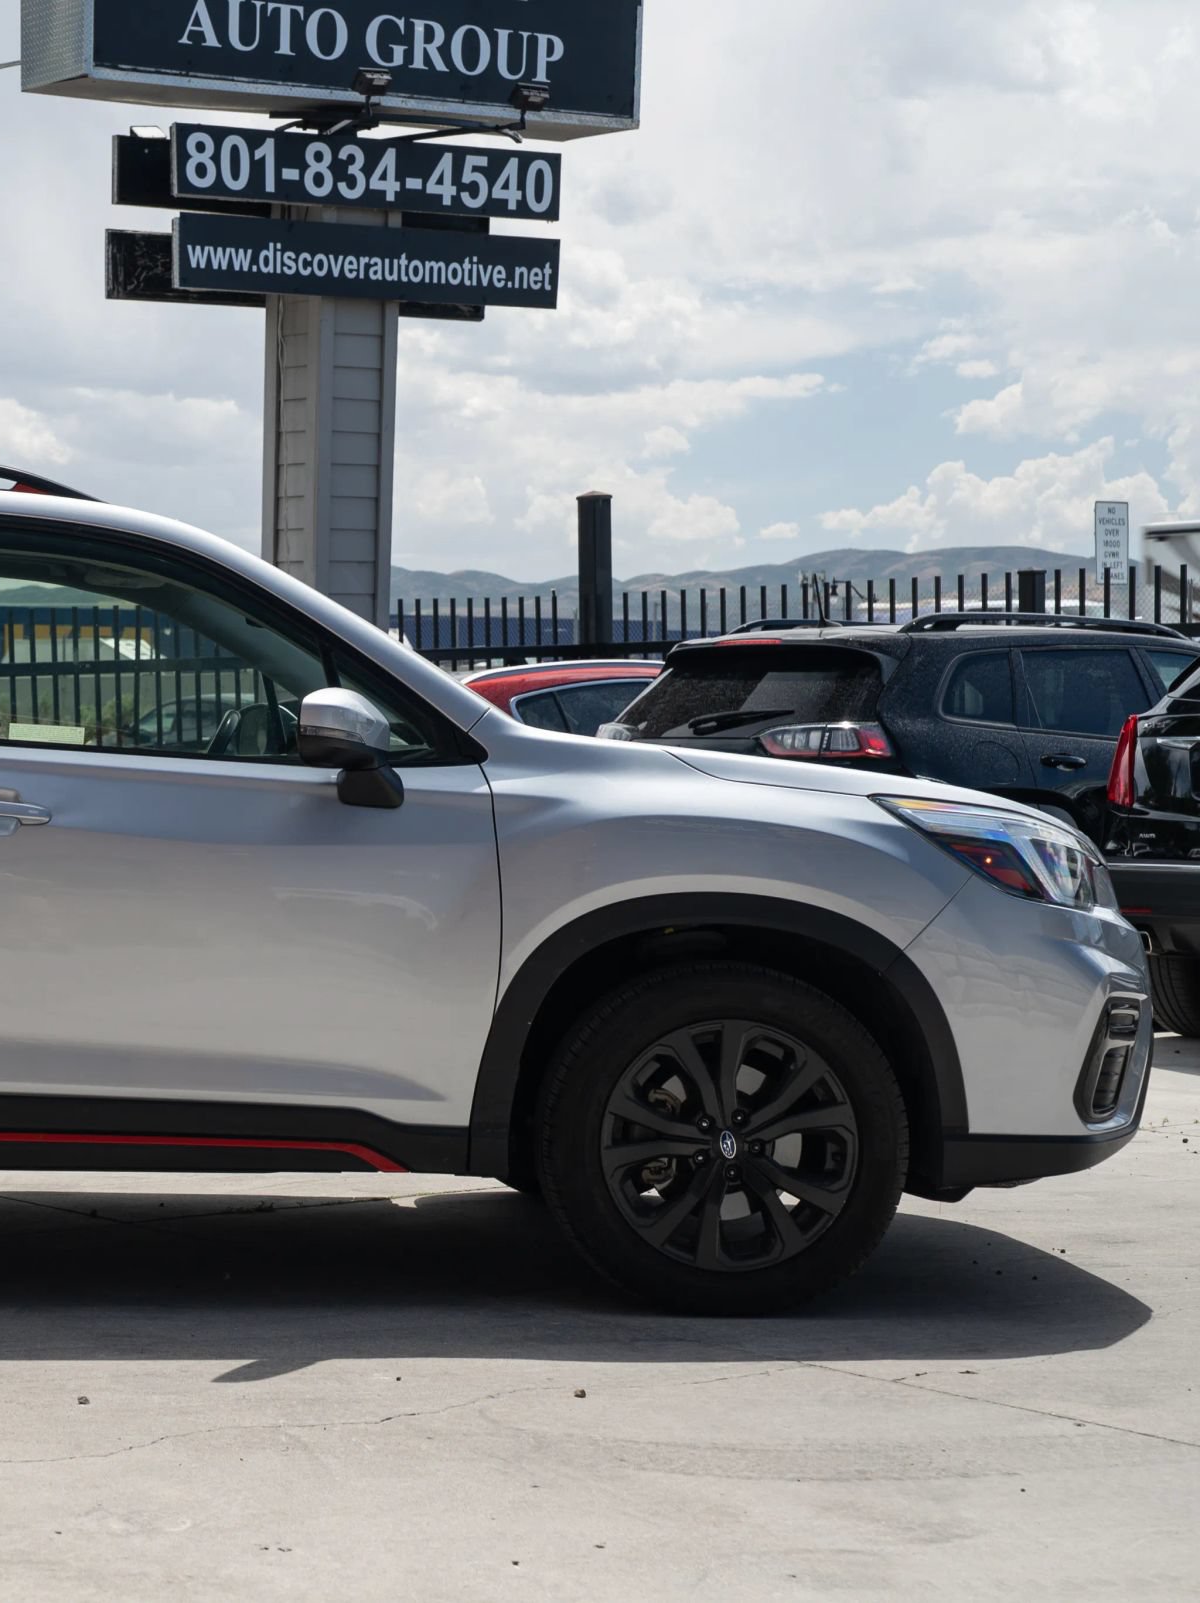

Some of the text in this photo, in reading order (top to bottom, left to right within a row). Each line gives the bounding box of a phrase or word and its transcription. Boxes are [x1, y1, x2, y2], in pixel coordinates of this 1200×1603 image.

[177, 0, 565, 83] AUTO GROUP
[185, 131, 553, 213] 801-834-4540
[187, 242, 553, 291] www.discoverautomotive.net
[1098, 517, 1126, 526] VEHICLES
[1105, 528, 1120, 537] OVER
